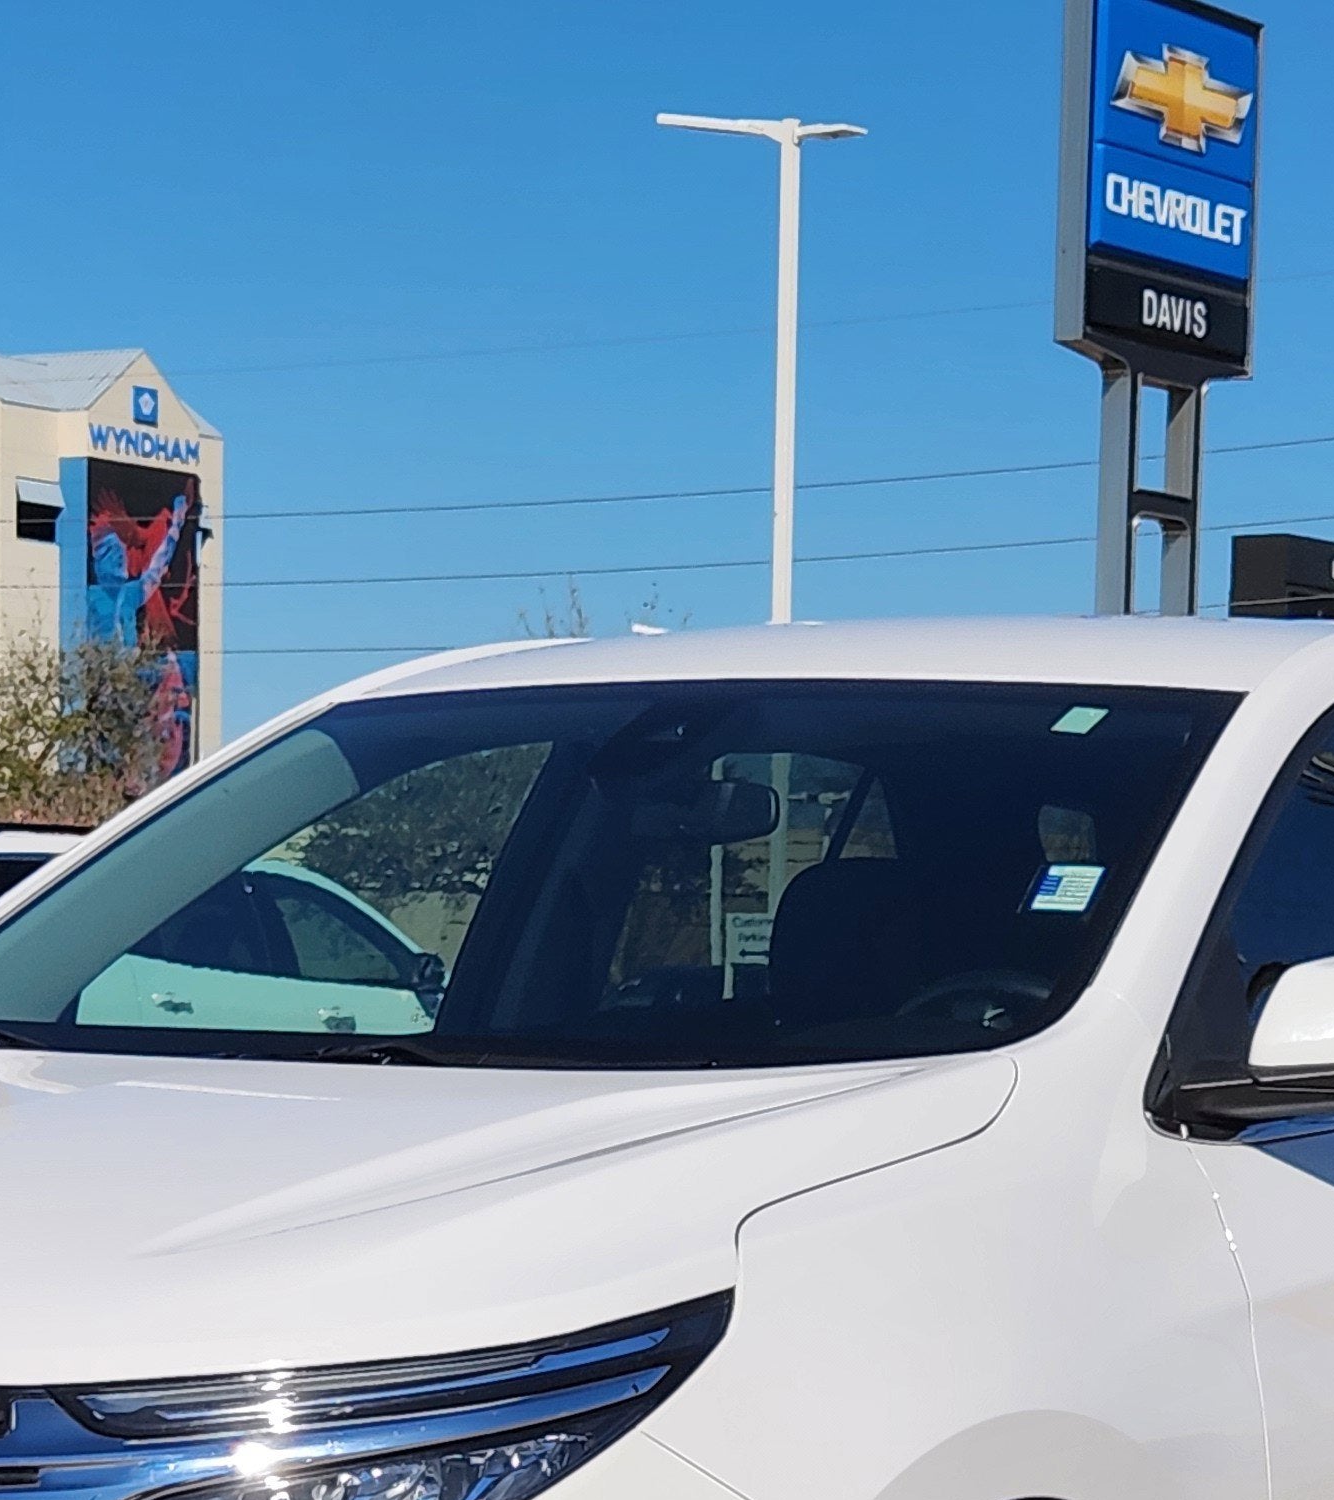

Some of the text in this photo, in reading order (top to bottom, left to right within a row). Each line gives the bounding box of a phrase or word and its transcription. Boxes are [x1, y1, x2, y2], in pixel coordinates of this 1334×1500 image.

[1105, 172, 1248, 247] CHEVROLET
[1141, 288, 1209, 340] DAVIS
[87, 422, 201, 467] WYNDHAM
